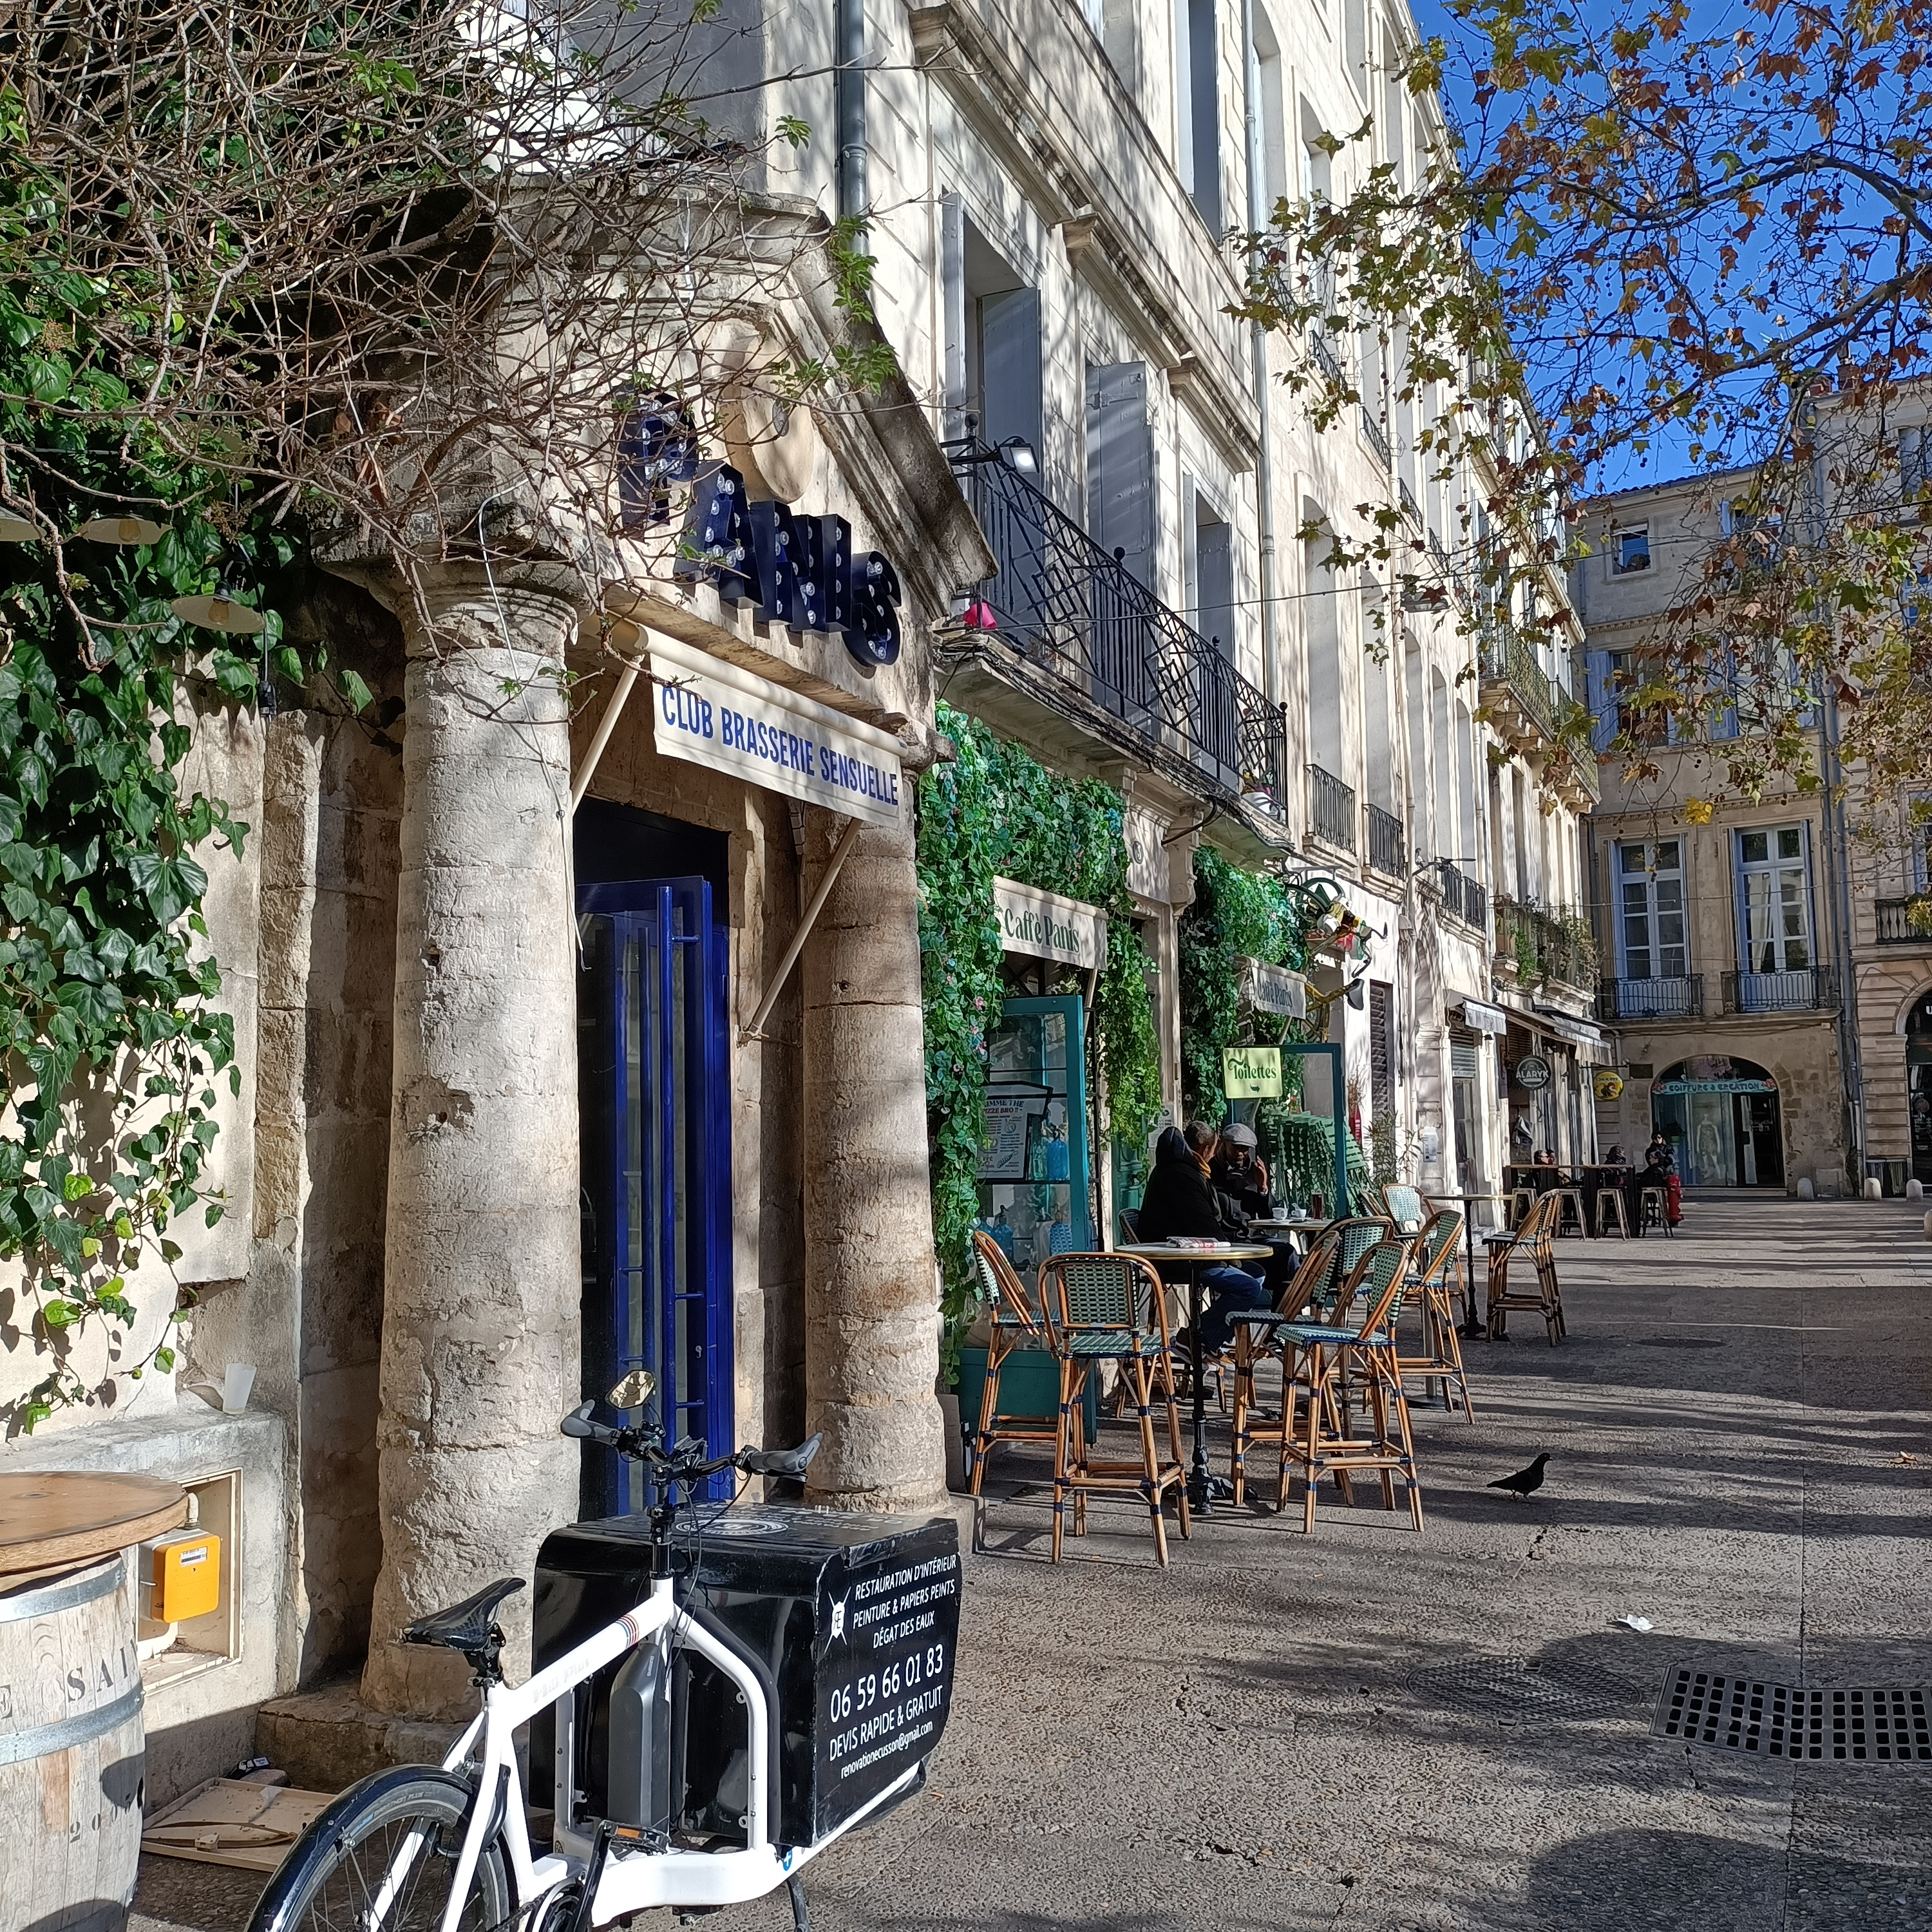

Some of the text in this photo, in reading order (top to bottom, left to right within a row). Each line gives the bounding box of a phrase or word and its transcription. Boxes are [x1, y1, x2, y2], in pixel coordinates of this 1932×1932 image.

[661, 687, 898, 806] CLUB BRASSERIE SENSUELLE
[1004, 908, 1080, 953] Caffè Panis
[1274, 983, 1293, 1009] Panis
[1227, 1057, 1276, 1079] Toilettes
[1515, 1070, 1549, 1079] ALARYK
[1008, 1099, 1025, 1108] THE
[855, 1554, 957, 1601] RESTAURATION D'INTÉRIEUR
[853, 1578, 956, 1630] PEINTURE & PAPIERS PEINTS
[873, 1611, 935, 1649] DÉGAT DES EAUX
[830, 1643, 944, 1723] 06 59 66 01 83
[829, 1685, 943, 1762] DEVIS RAPIDE & GRATUIT
[840, 1719, 934, 1780] renovationecusson@gmail.com
